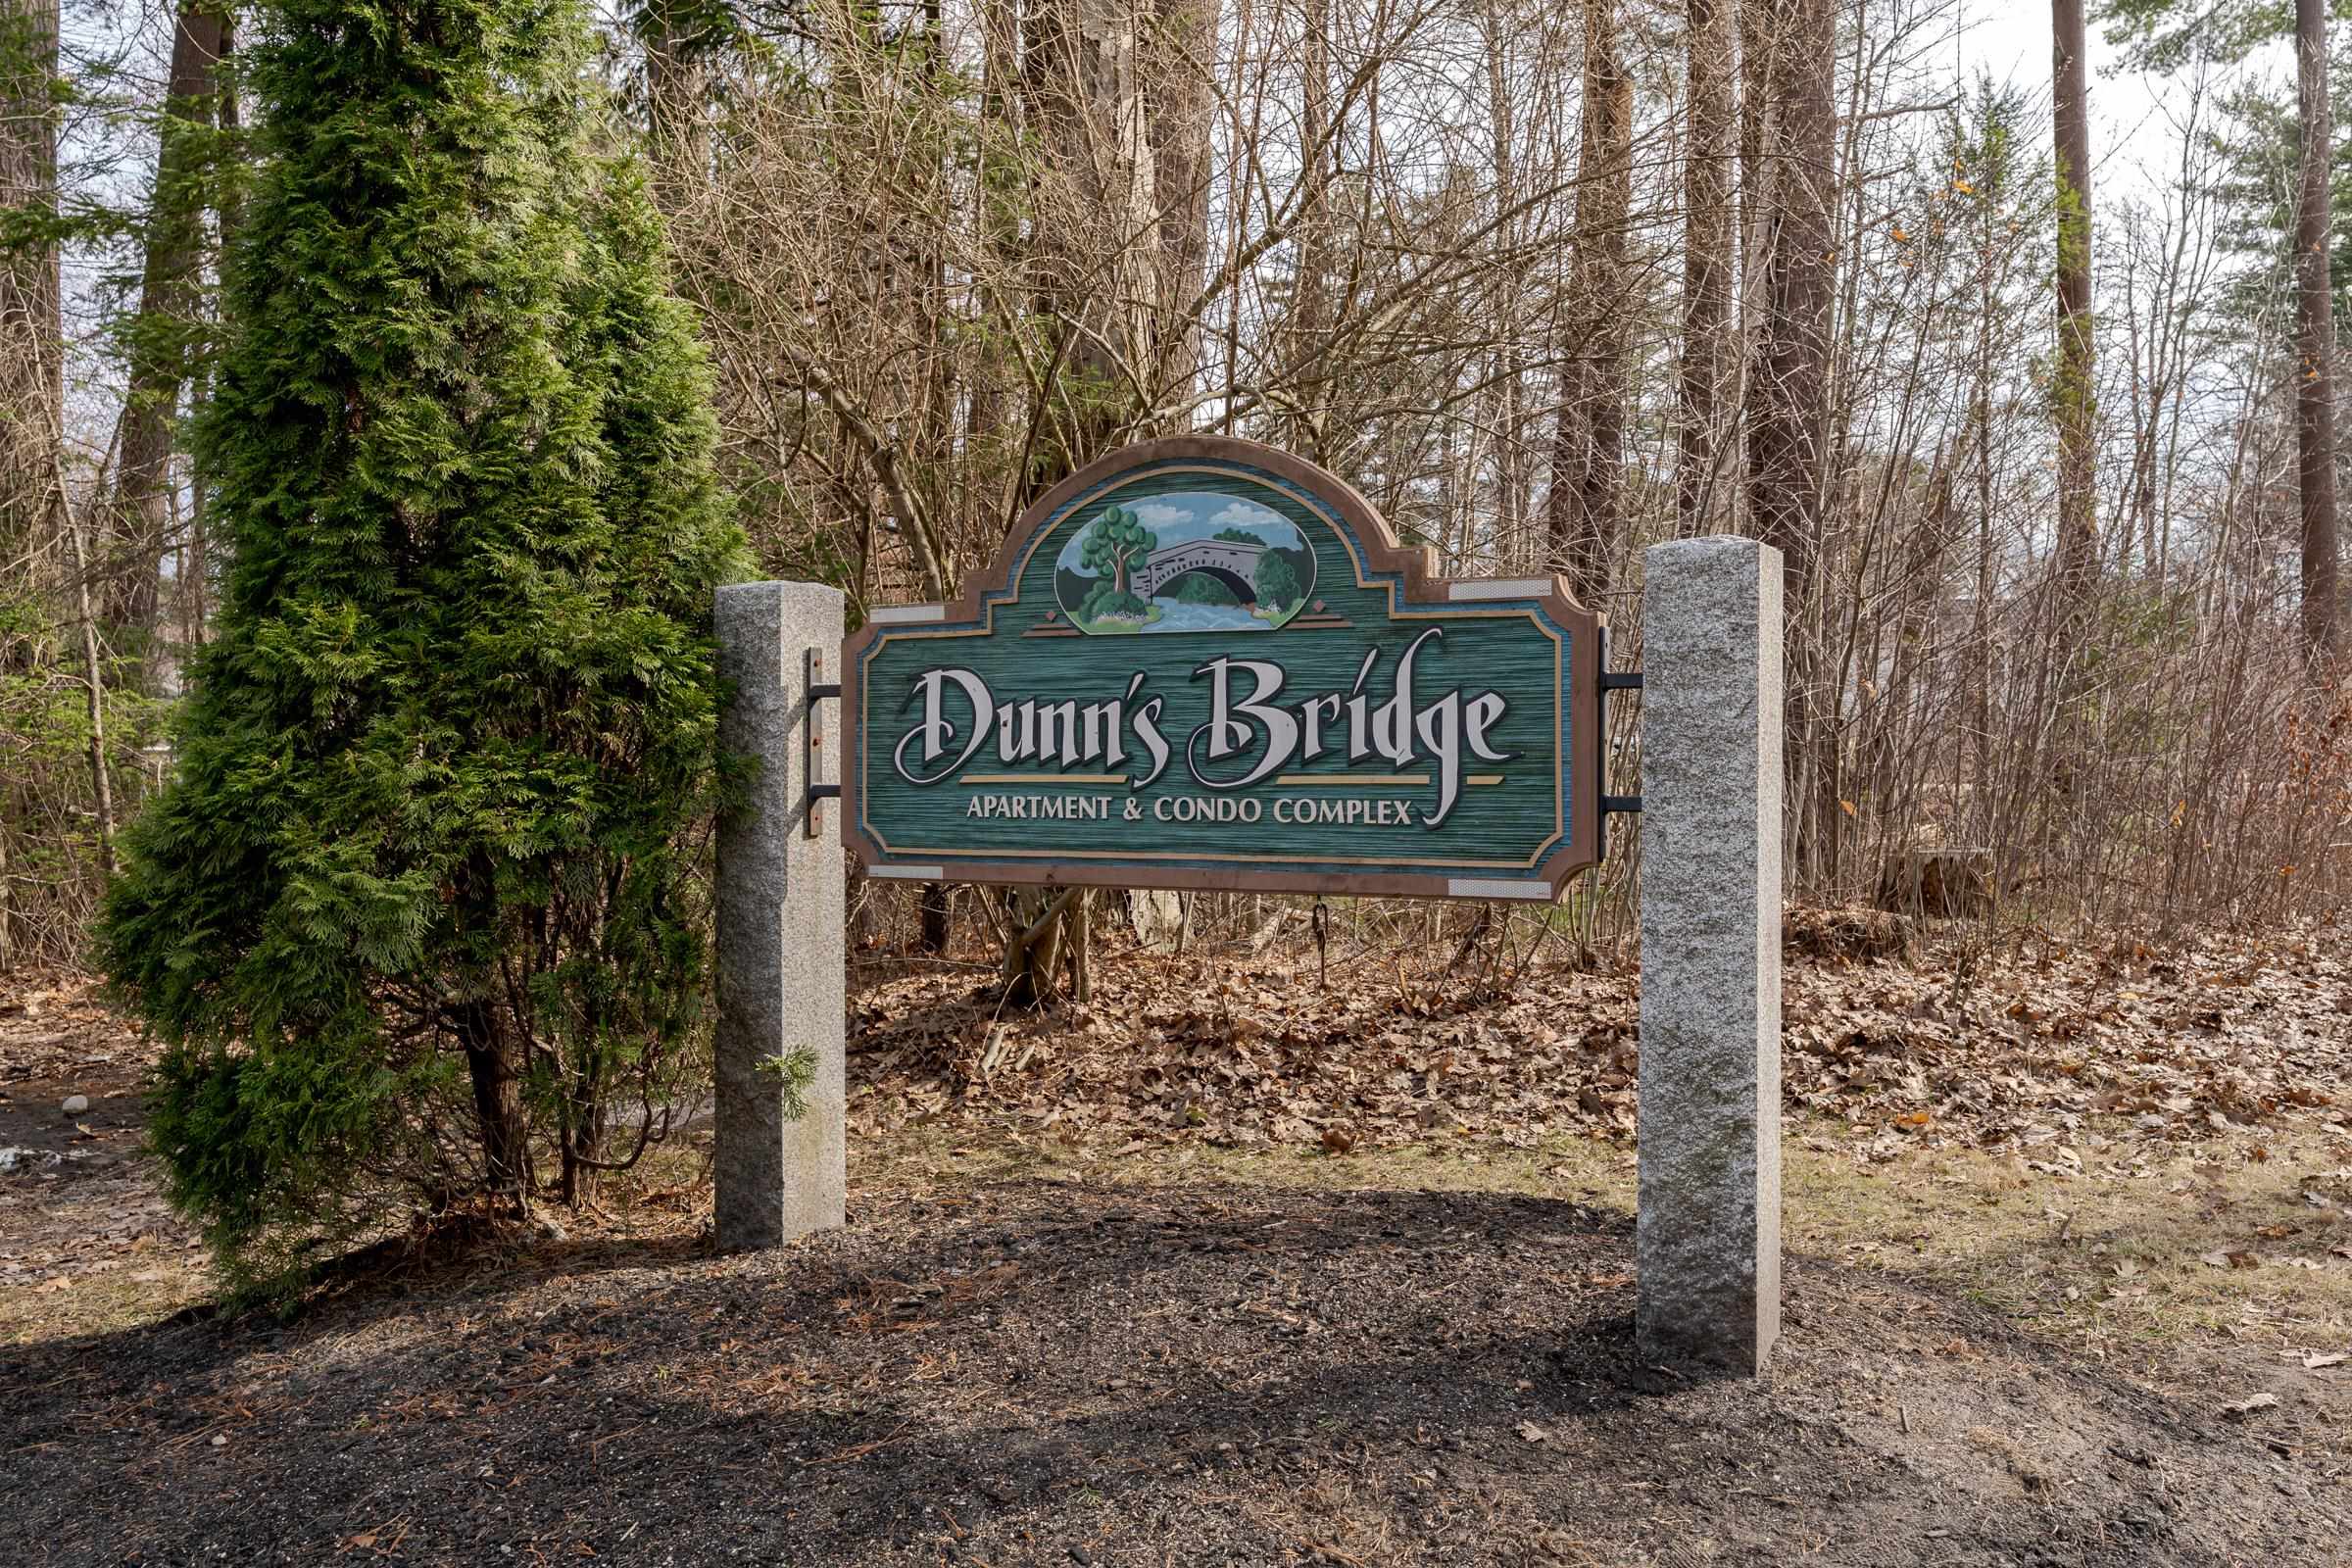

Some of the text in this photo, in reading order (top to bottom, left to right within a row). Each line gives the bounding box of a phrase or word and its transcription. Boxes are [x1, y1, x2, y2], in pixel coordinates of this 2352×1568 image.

[894, 628, 1510, 825] Dunn's Bridge
[965, 795, 1412, 825] APARTMENT & CONDO COMPLEX
